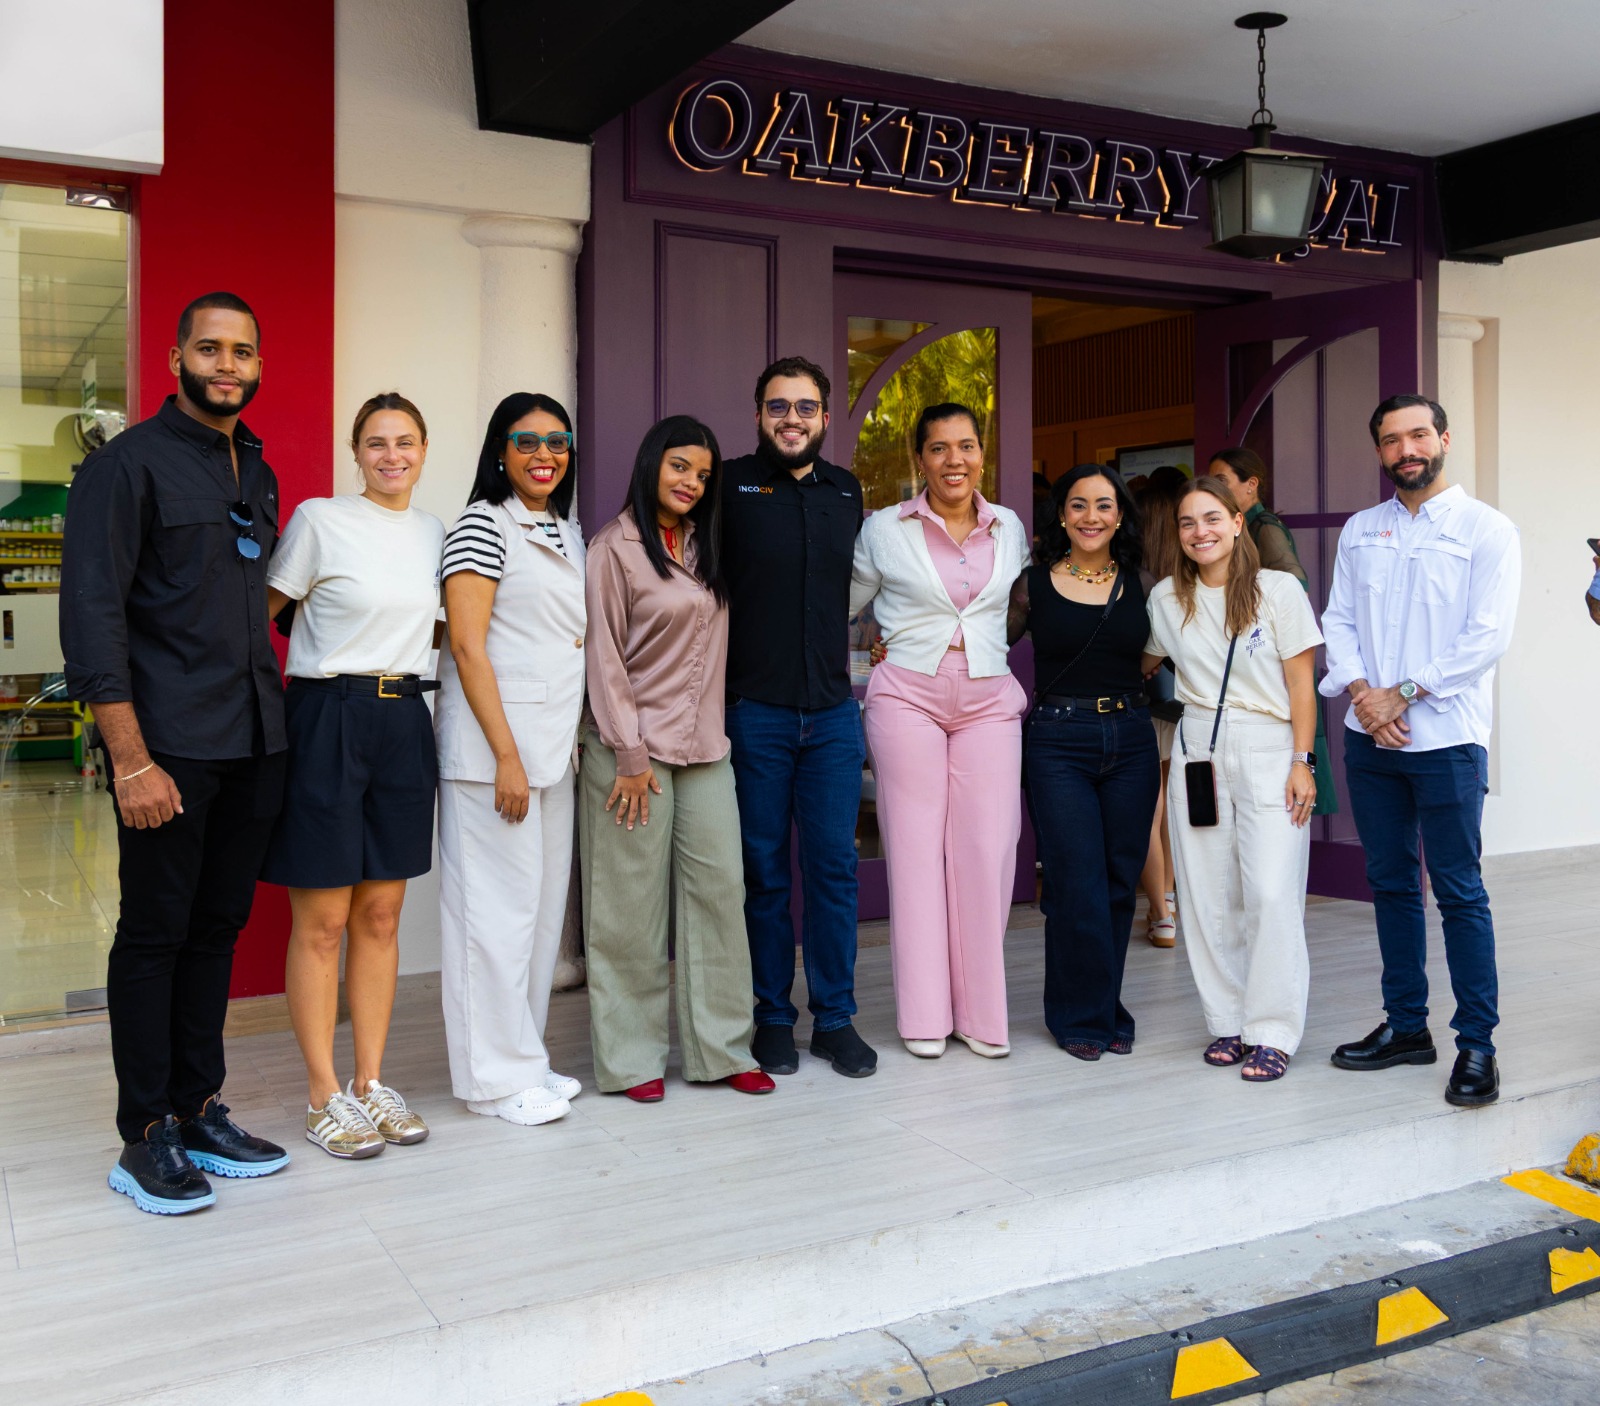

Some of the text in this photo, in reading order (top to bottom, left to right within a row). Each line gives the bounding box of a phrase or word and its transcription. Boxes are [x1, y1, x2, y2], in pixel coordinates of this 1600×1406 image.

[678, 76, 1223, 225] OAKBERRY
[738, 485, 774, 494] INCOCIV
[1246, 640, 1265, 650] BERRY
